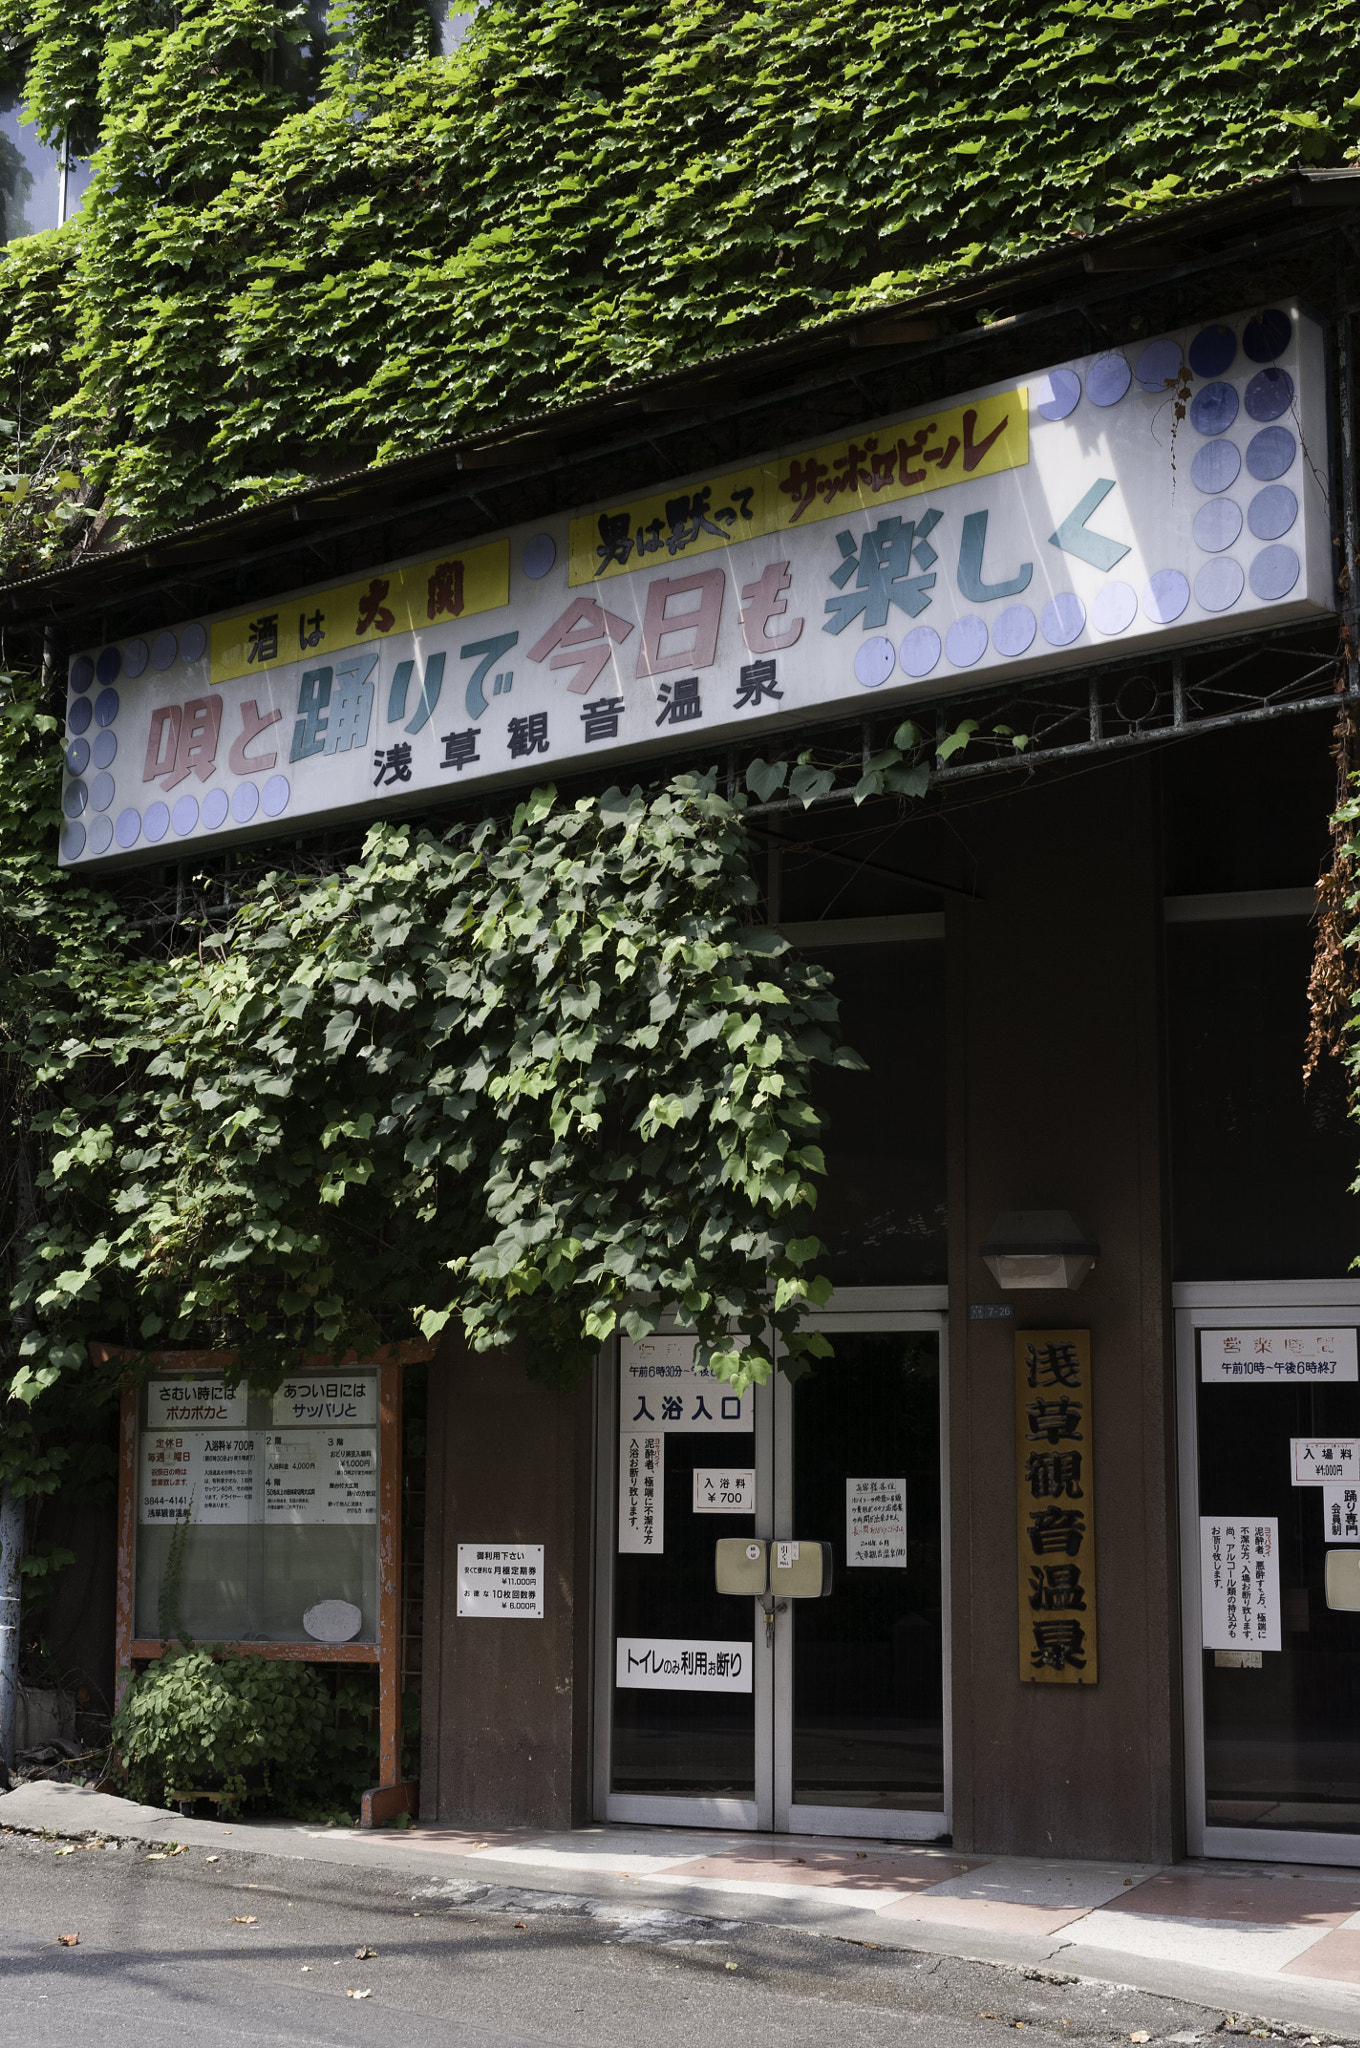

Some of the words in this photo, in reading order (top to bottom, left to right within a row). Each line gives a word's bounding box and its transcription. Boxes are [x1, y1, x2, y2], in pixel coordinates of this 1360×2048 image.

[780, 409, 1008, 523] サッポロビール
[373, 660, 784, 787] 浅草観音温泉
[988, 1307, 1010, 1316] 7-26
[159, 1386, 237, 1401] さむい時には
[284, 1383, 366, 1398] あつい日には
[633, 1395, 741, 1421] 入浴入口
[156, 1438, 183, 1448] 定休日
[1304, 1448, 1352, 1460] 入場料
[148, 1452, 190, 1462] 毎週曜日
[629, 1438, 639, 1530] 入浴お断り致します。
[644, 1438, 655, 1544] 泥酔者、極端に不潔な方
[704, 1478, 745, 1489] 入浴料
[144, 1497, 187, 1505] 3844-4141
[1024, 1340, 1087, 1671] 浅草観音温泉
[1344, 1489, 1358, 1536] 踊り専門
[1331, 1503, 1341, 1536] 会員制
[476, 1551, 525, 1560] 御利用下さい
[1226, 1526, 1237, 1639] 尚、アルコール類の持込みも
[627, 1648, 742, 1678] トイレのみ利用お断り
